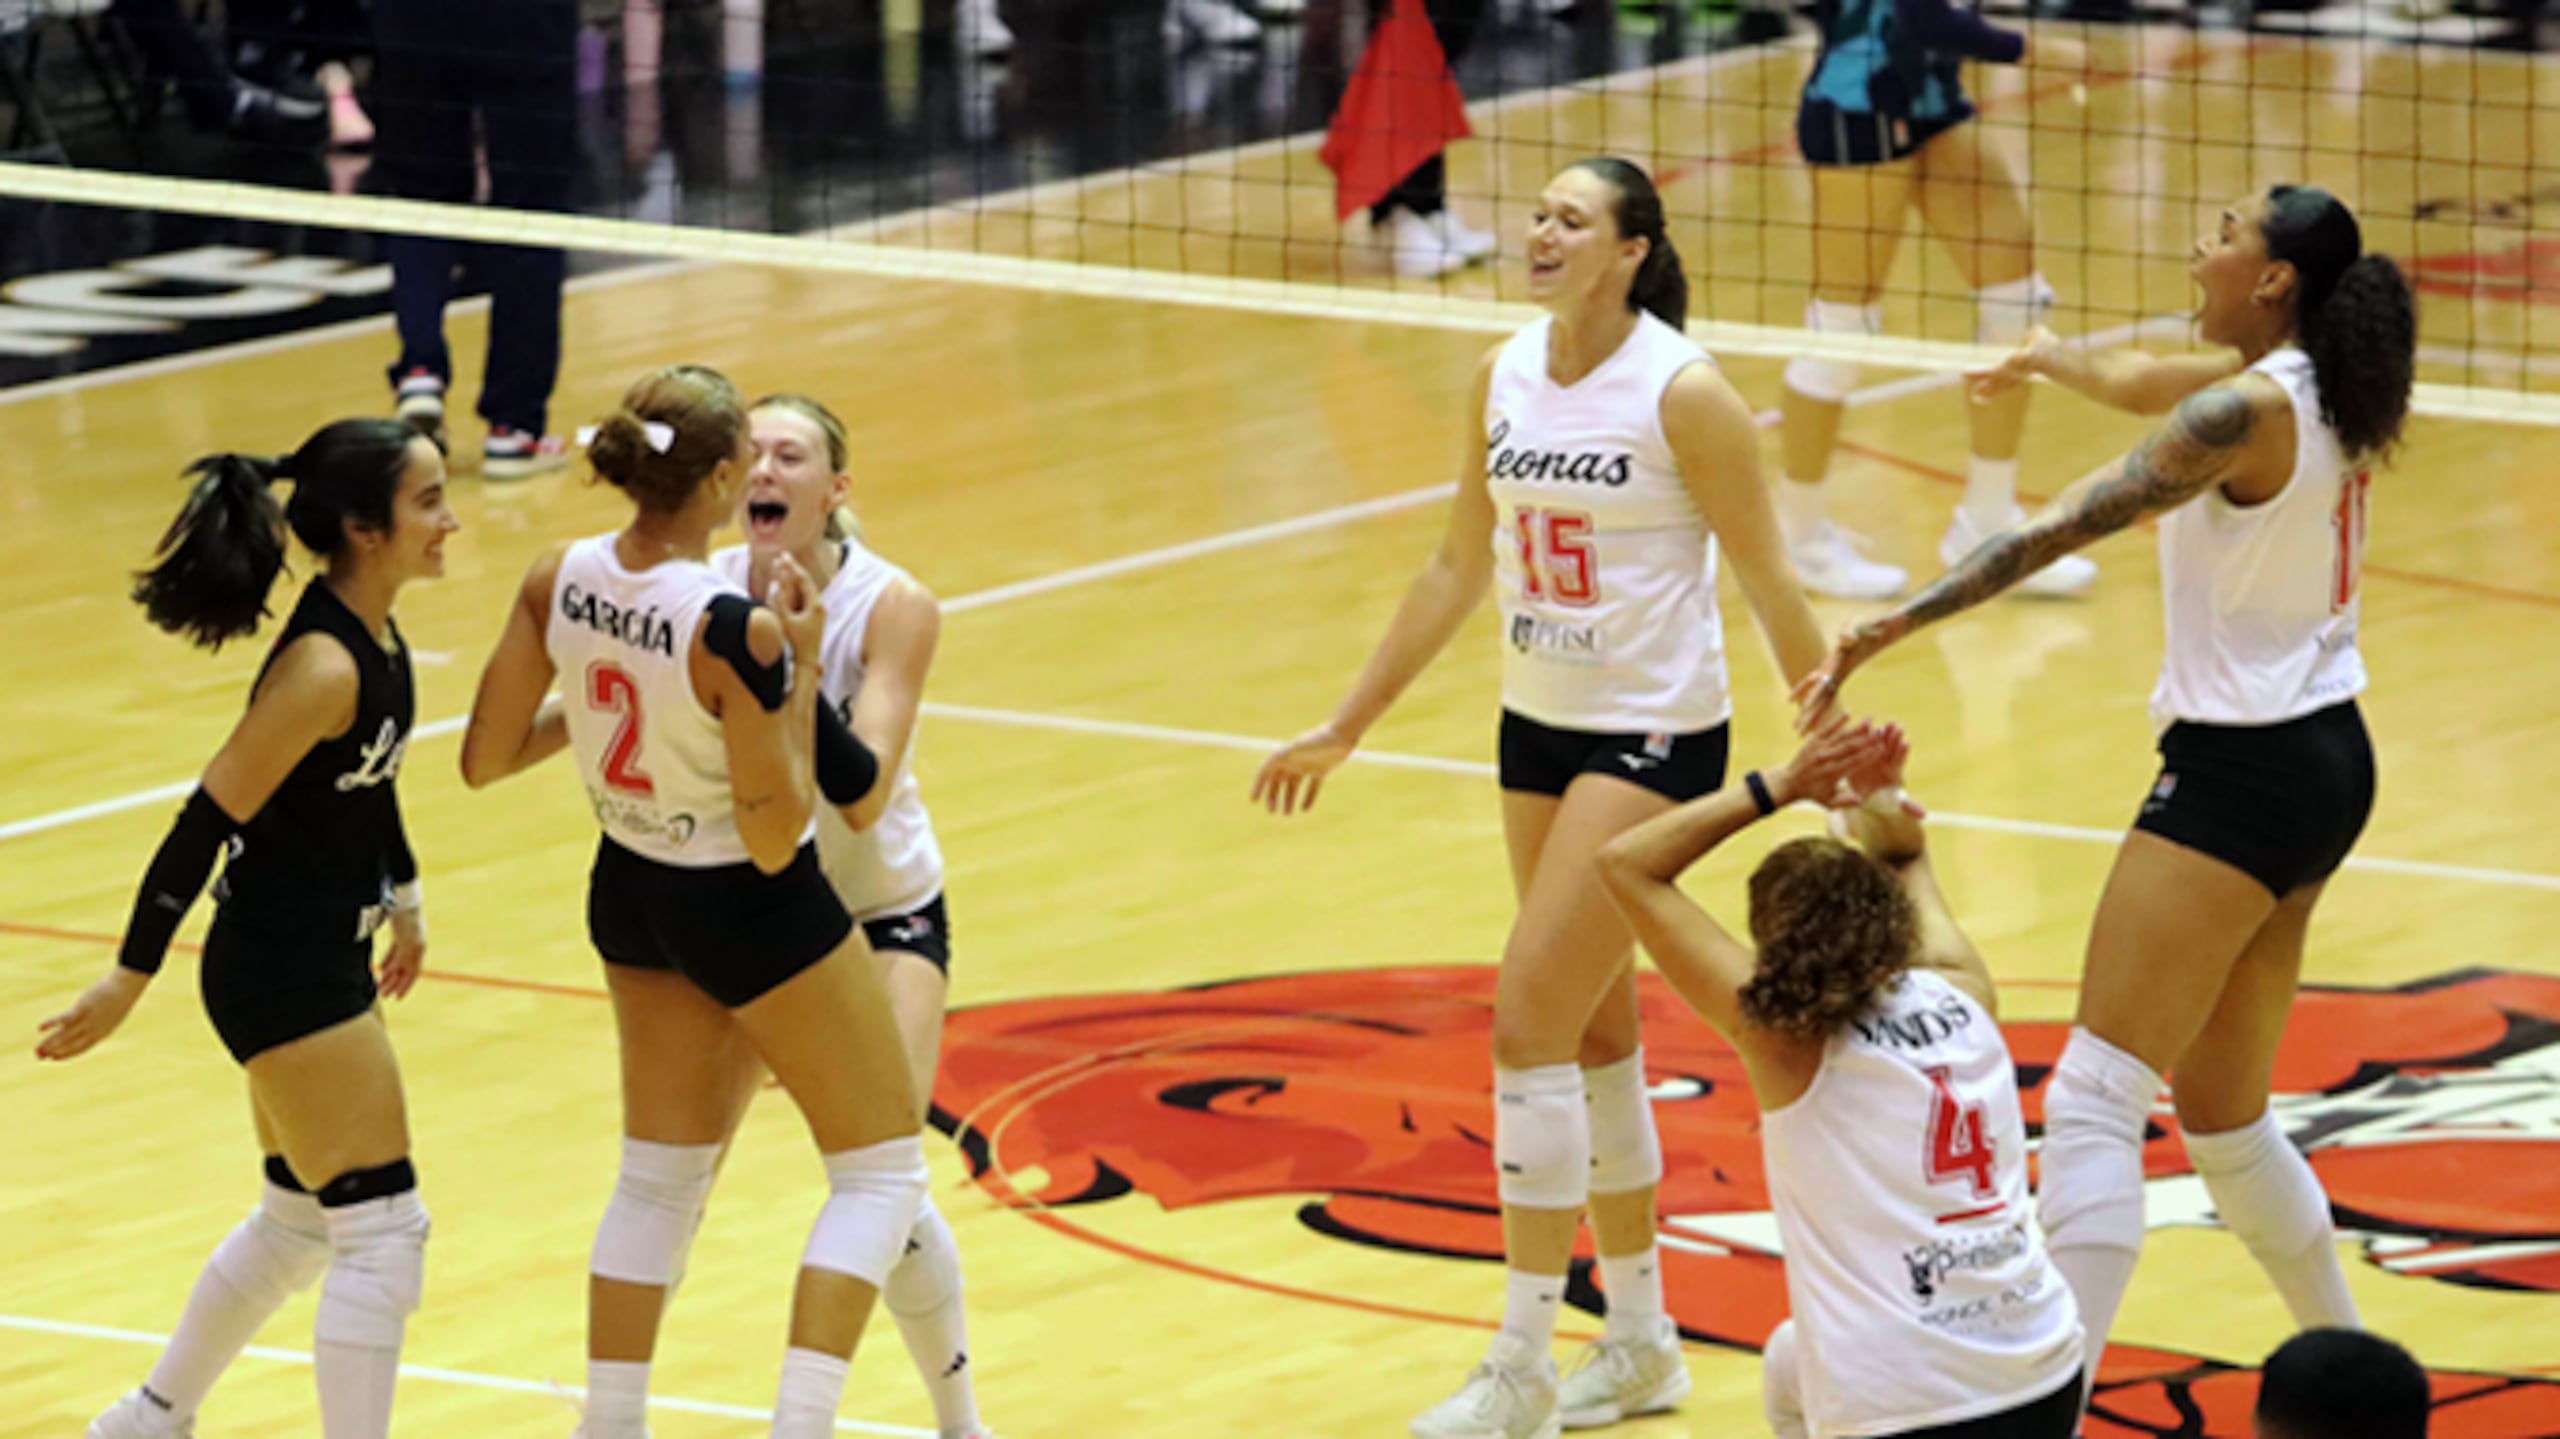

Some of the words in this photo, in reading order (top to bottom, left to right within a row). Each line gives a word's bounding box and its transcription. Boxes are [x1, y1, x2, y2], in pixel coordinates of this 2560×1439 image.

[1515, 505, 1602, 608] 15
[561, 582, 673, 657] GARCÍA
[586, 659, 656, 799] 2
[1922, 1065, 1998, 1200] 4
